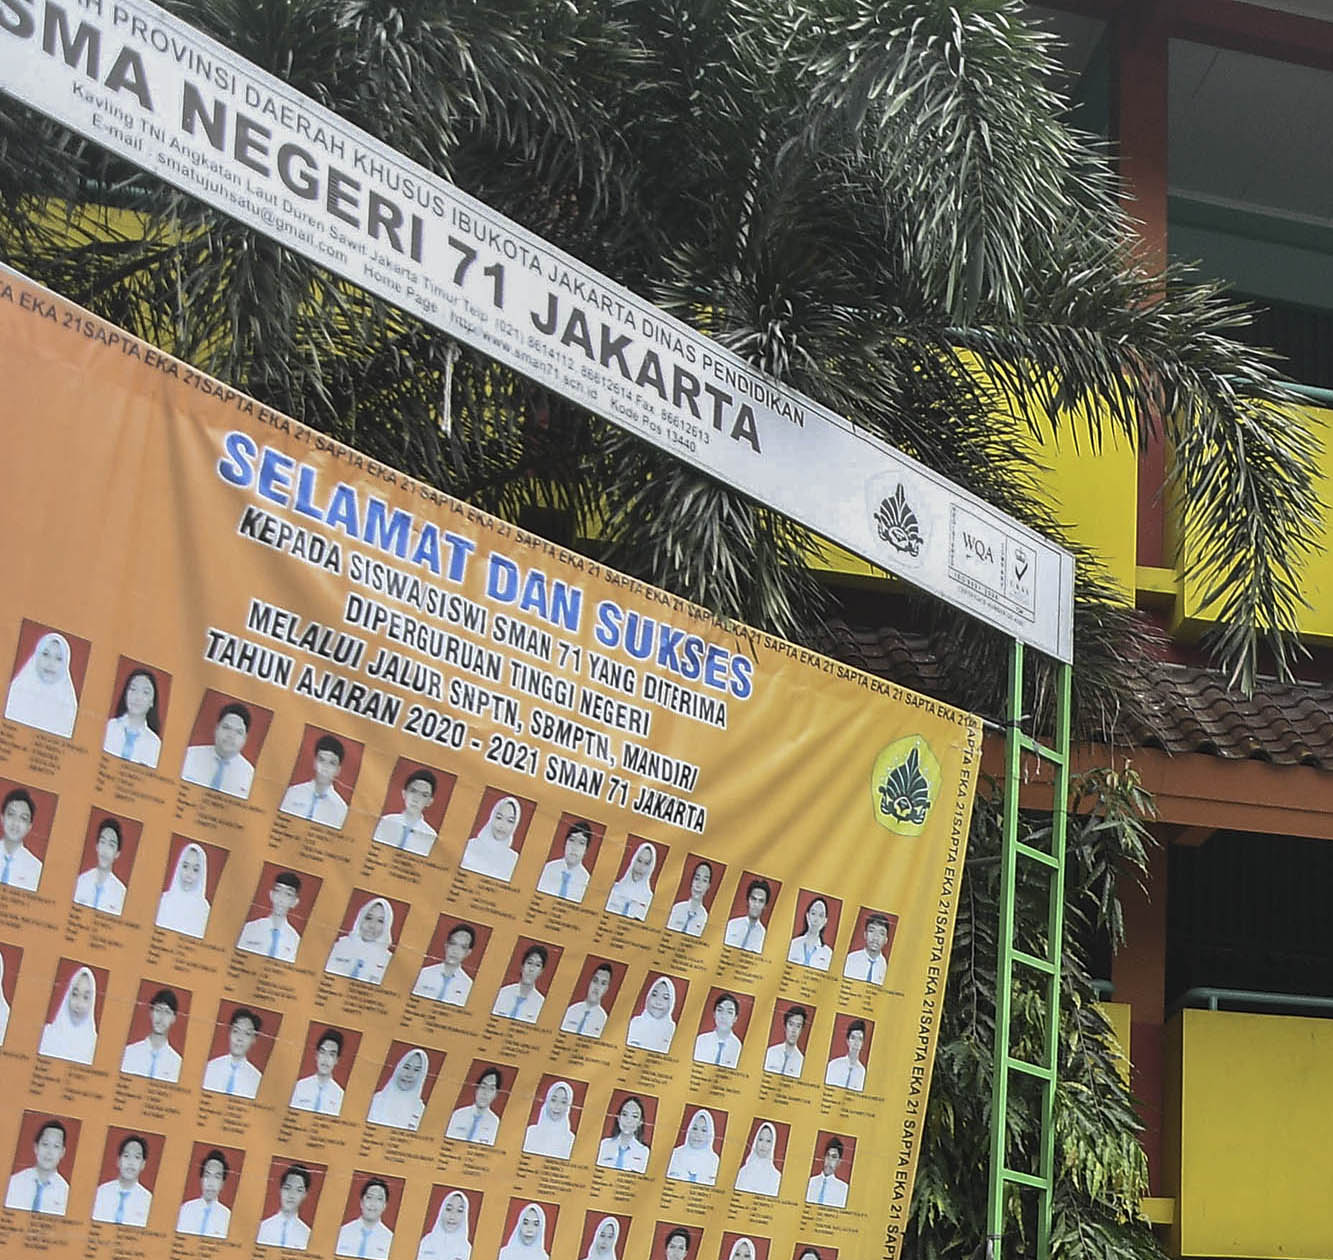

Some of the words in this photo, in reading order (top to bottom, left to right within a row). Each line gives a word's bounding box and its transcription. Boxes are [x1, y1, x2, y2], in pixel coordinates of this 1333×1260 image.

[92, 112, 142, 152] E-mail
[72, 81, 133, 129] Kavling
[140, 118, 165, 143] TNI
[169, 137, 240, 187] Angkatan
[247, 176, 277, 207] Laut
[282, 197, 324, 233] Duren
[329, 224, 366, 256] Sawit
[369, 248, 417, 284] Jakarta
[424, 276, 457, 306] Timur
[113, 6, 235, 94] PROVINSI
[245, 85, 345, 160] DAERAH
[354, 150, 443, 218] KHUSUS
[452, 206, 541, 274] IBUKOTA
[548, 265, 636, 330] JAKARTA
[642, 317, 696, 364] DINAS
[702, 354, 805, 428] PENDIDIKAN
[0, 0, 154, 112] SMA
[181, 79, 422, 264] NEGERI
[447, 234, 504, 309] 71
[530, 293, 762, 455] JAKARTA
[19, 289, 57, 323] EKA
[144, 346, 178, 379] EKA
[258, 405, 290, 434] EKA
[367, 459, 396, 486] EKA
[467, 508, 493, 530] EKA
[497, 522, 510, 539] 21
[515, 530, 554, 558] SAPTA
[559, 550, 585, 572] EKA
[588, 562, 600, 578] 21
[604, 569, 641, 595] SAPTA
[645, 587, 669, 607] EKA
[764, 636, 797, 660] SAPTA
[800, 650, 819, 669] EKA
[823, 660, 833, 674] 21
[837, 665, 867, 687] SAPTA
[870, 678, 889, 696] EKA
[892, 687, 902, 702] 21
[905, 692, 934, 714] SAPTA
[937, 706, 955, 723] EKA
[218, 431, 474, 585] SELAMAT
[486, 552, 581, 633] DAN
[596, 602, 752, 698] SUKSES
[962, 531, 994, 563] WQA
[239, 506, 340, 573] KEPADA
[493, 615, 550, 662] SMAN
[558, 641, 582, 672] 71
[589, 652, 633, 693] YANG
[644, 674, 726, 729] DITERIMA
[345, 593, 501, 681] DIPERGURUAN
[511, 660, 574, 709] TINGGI
[580, 689, 649, 735] NEGERI
[248, 600, 364, 669] MELALUI
[368, 651, 441, 699] JALUR
[450, 680, 521, 733] SNPTN,
[531, 710, 615, 766] SBMPTN,
[623, 743, 698, 791] MANDIRI
[206, 630, 291, 686] TAHUN
[296, 666, 400, 725] AJARAN
[404, 704, 465, 748] 2020
[487, 737, 539, 774] 2021
[546, 756, 602, 796] SMAN
[608, 778, 628, 805] 71
[634, 789, 706, 833] JAKARTA
[957, 769, 970, 798] EKA
[940, 868, 955, 897] EKA
[924, 967, 940, 995] EKA
[908, 1067, 924, 1096] EKA
[905, 1100, 918, 1115] 21
[897, 1120, 916, 1167] SAPTA
[891, 1171, 907, 1200] EKA
[888, 1205, 902, 1220] 21
